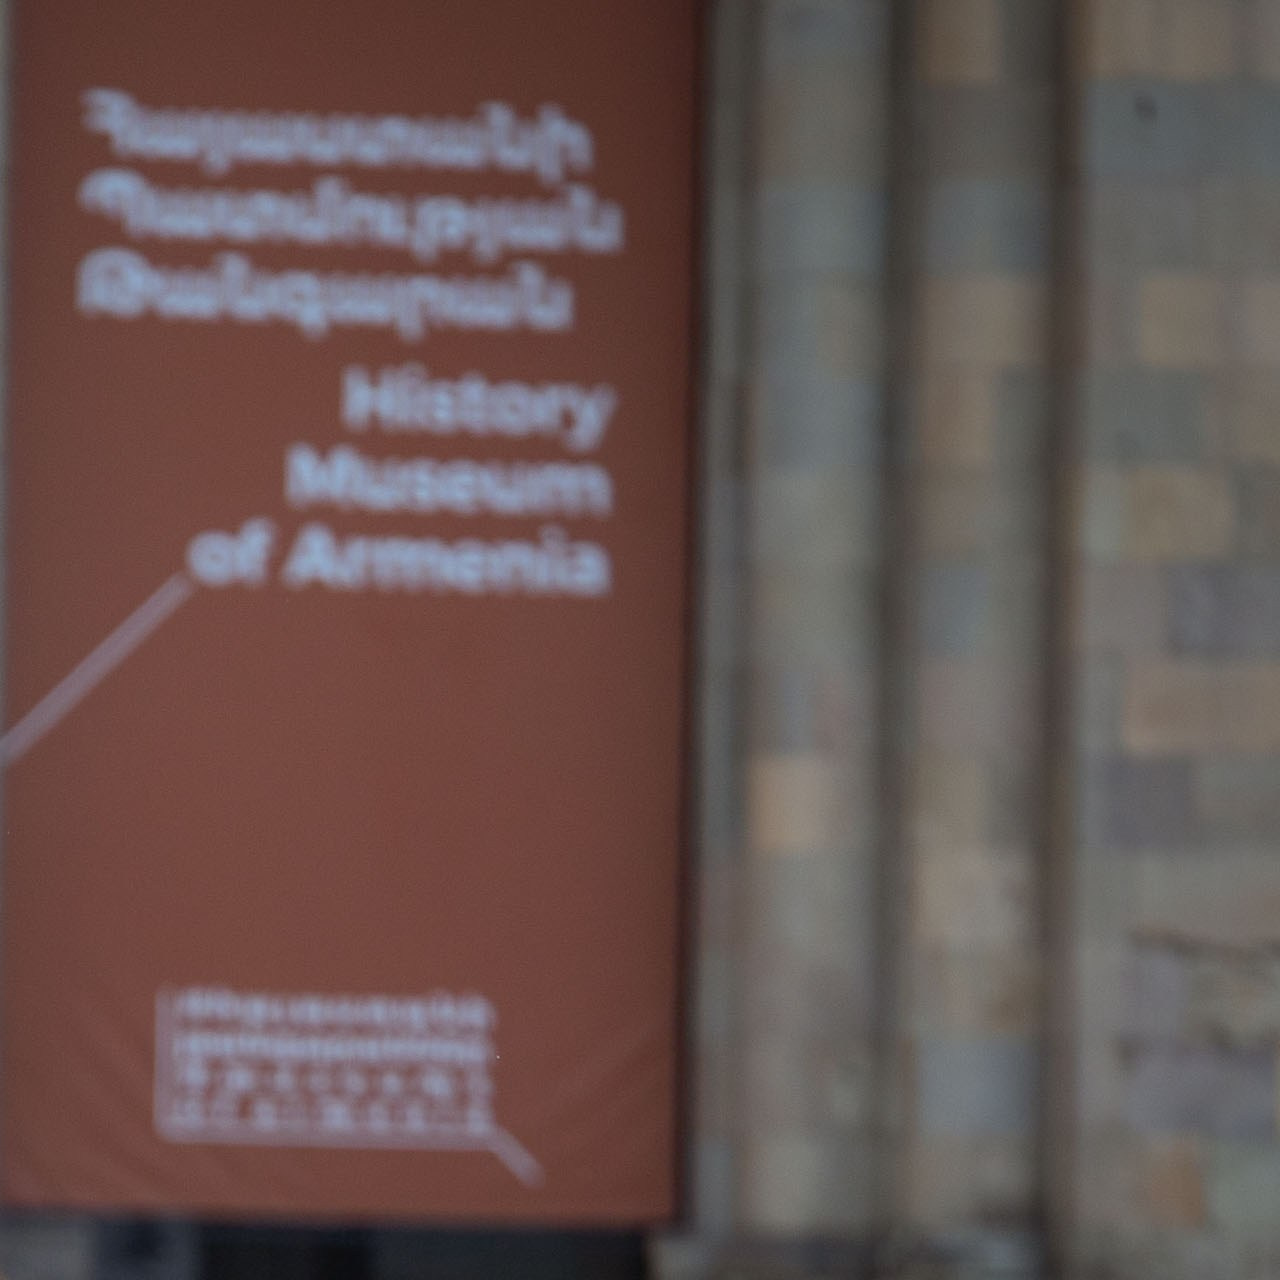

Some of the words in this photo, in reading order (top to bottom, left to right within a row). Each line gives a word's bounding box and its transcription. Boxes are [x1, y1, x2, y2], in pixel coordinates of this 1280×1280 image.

[342, 366, 616, 450] History
[288, 444, 612, 514] Museum
[188, 518, 272, 588] of
[286, 524, 610, 594] Armenia
